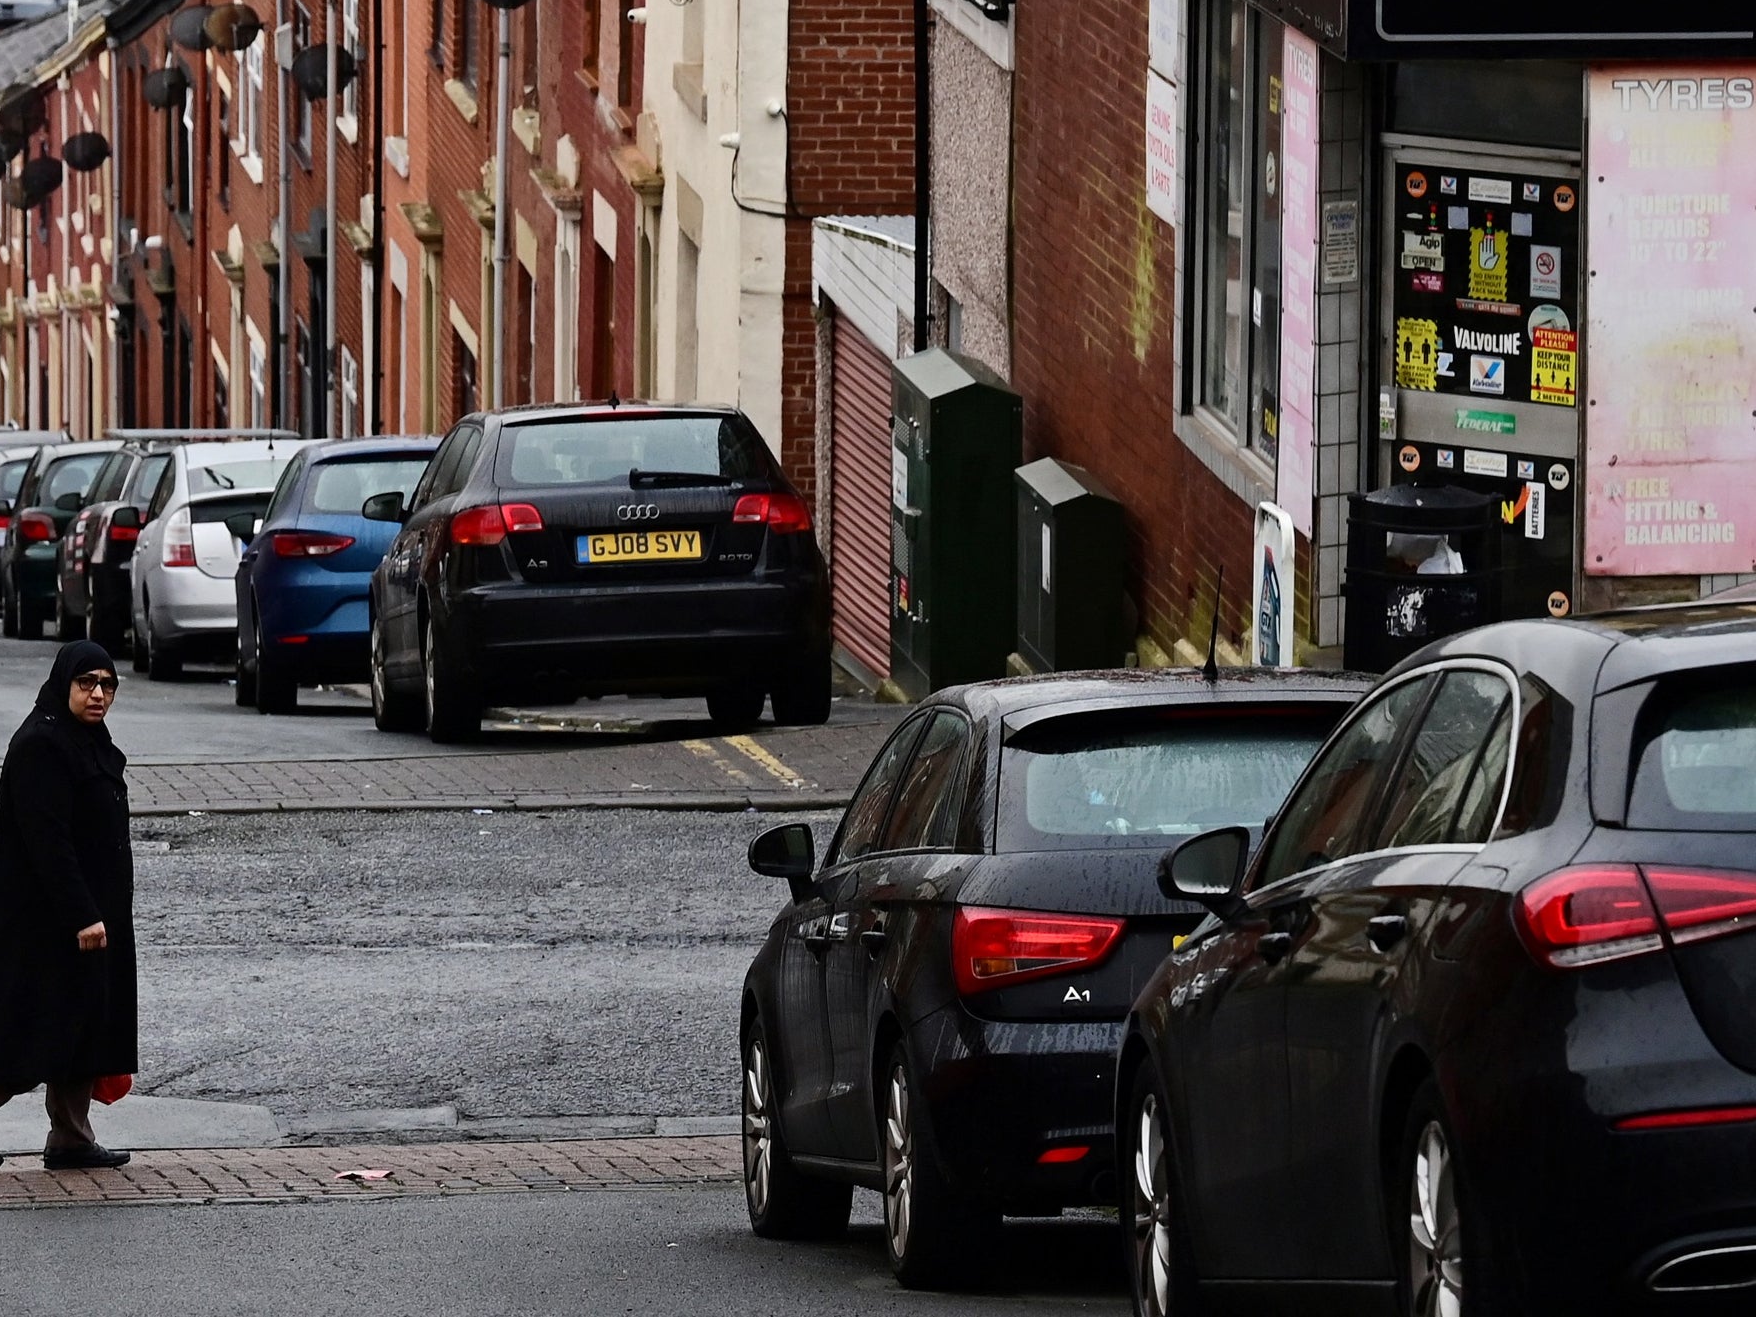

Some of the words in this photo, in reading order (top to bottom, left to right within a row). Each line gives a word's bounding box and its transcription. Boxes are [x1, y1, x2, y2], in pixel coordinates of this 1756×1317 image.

[1289, 41, 1313, 85] TYRES
[1612, 77, 1753, 111] TYRES
[1627, 194, 1730, 215] PUNCTURE
[1627, 218, 1710, 239] REPAIRS
[1412, 256, 1436, 267] OPEN
[1453, 325, 1522, 355] VALVOLINE
[1535, 330, 1575, 343] ATTENTION
[1540, 339, 1569, 350] PLEASE!
[1536, 350, 1553, 359] KEEP
[1554, 352, 1571, 361] YOUR
[1536, 359, 1571, 372] DISTANCE
[1542, 394, 1570, 404] METRES
[1456, 414, 1502, 432] FEDERAL
[1624, 476, 1671, 498] FREE
[1531, 490, 1540, 535] BATTERIES
[1625, 499, 1698, 522] FITTING
[1703, 503, 1718, 520] &
[591, 534, 650, 556] GJ08
[656, 532, 696, 554] SVY
[1624, 522, 1736, 545] BALANCING
[527, 558, 548, 568] A3
[1063, 986, 1091, 1003] A1
